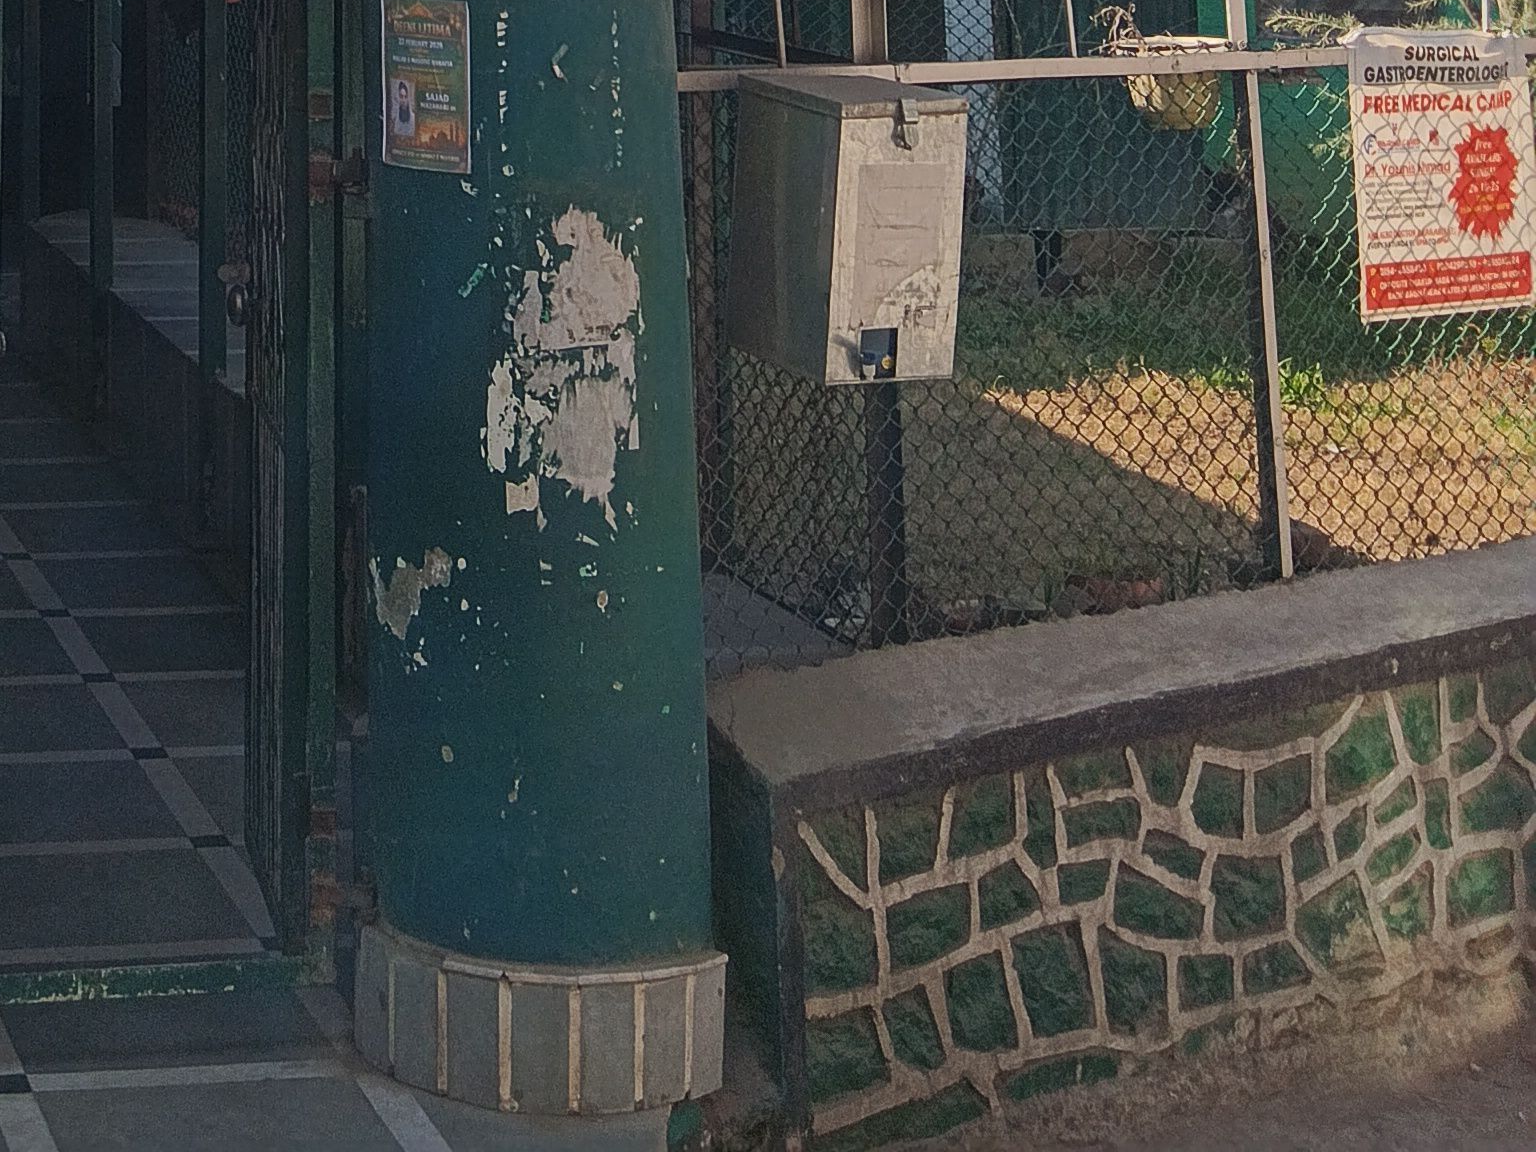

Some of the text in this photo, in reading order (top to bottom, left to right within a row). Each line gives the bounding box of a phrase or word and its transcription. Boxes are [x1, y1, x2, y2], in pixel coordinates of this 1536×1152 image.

[1405, 46, 1479, 62] SURGICAL
[1364, 90, 1512, 114] FREE MEDICAL CAMP
